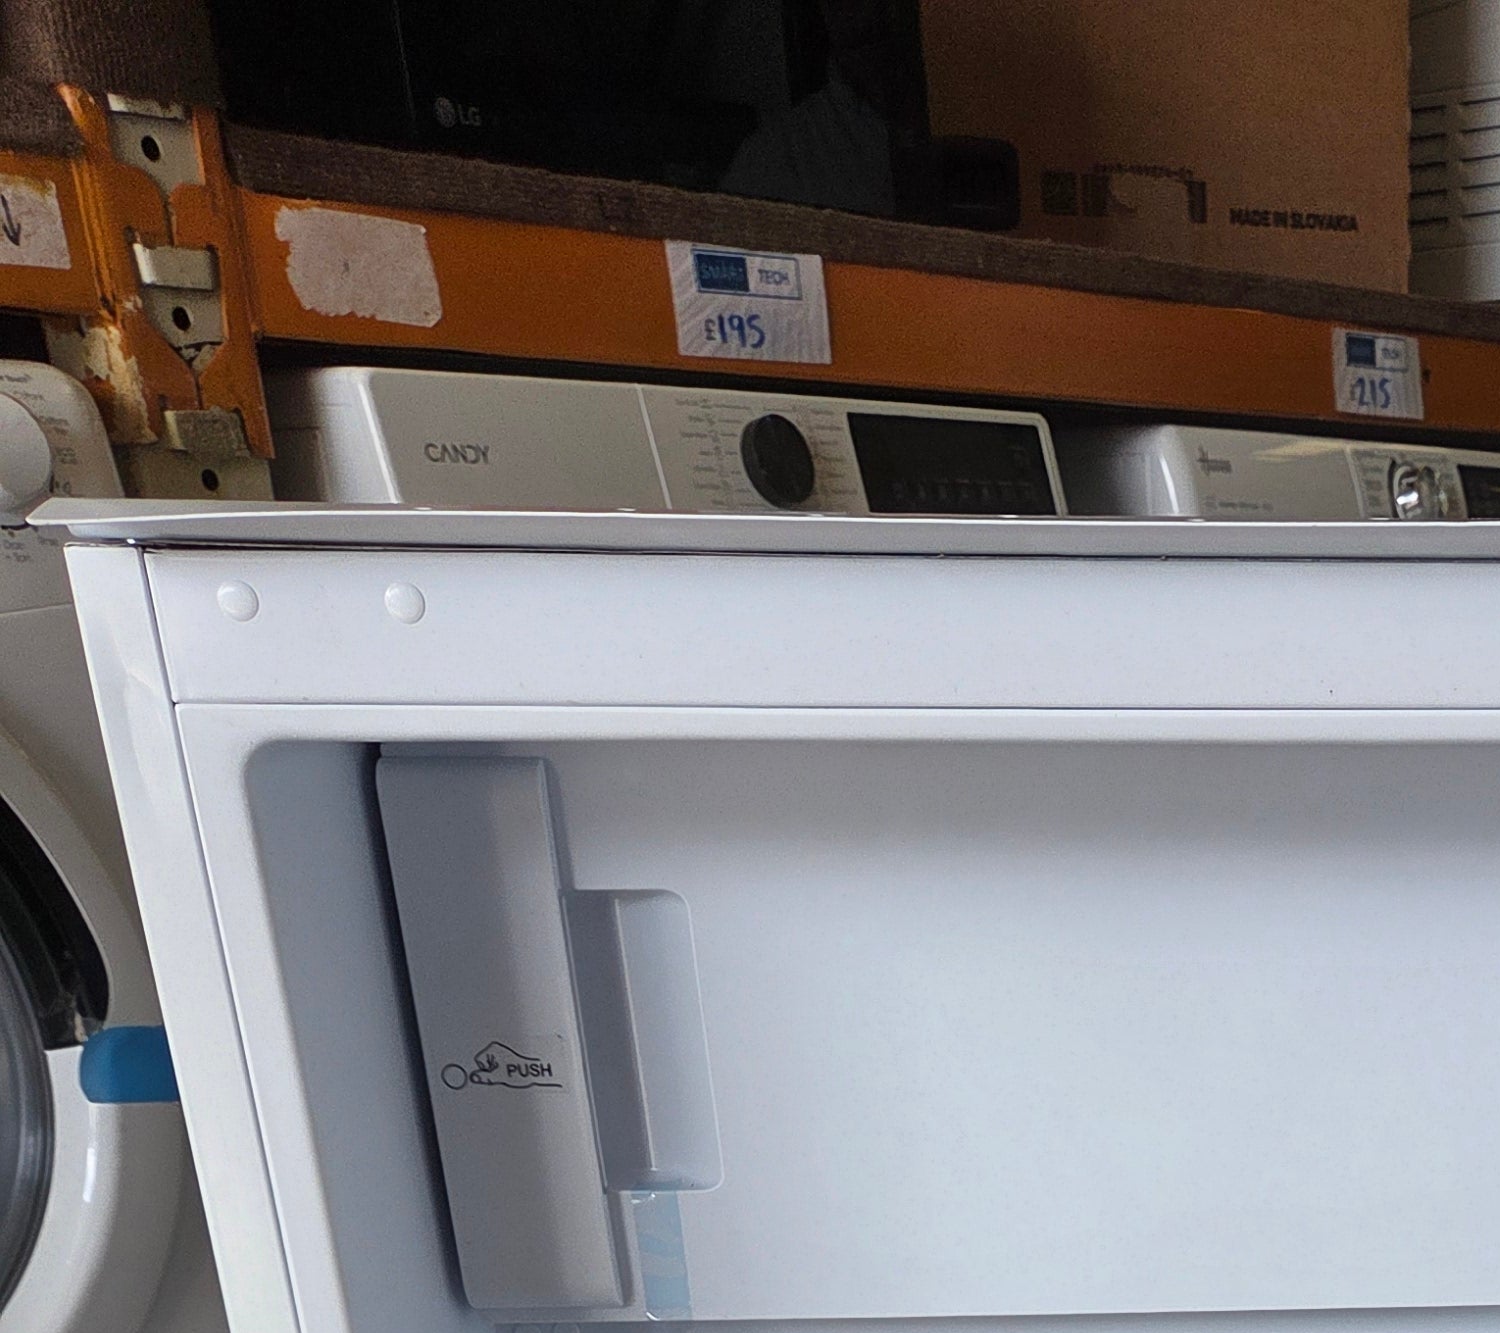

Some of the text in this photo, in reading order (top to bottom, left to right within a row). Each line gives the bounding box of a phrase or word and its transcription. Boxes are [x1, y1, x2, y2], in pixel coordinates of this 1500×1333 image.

[459, 103, 481, 126] LG
[1229, 207, 1359, 232] MADE IN SLOVAKIA
[704, 312, 766, 349] £195
[424, 442, 489, 464] CANDY
[506, 1063, 553, 1079] PUSH
